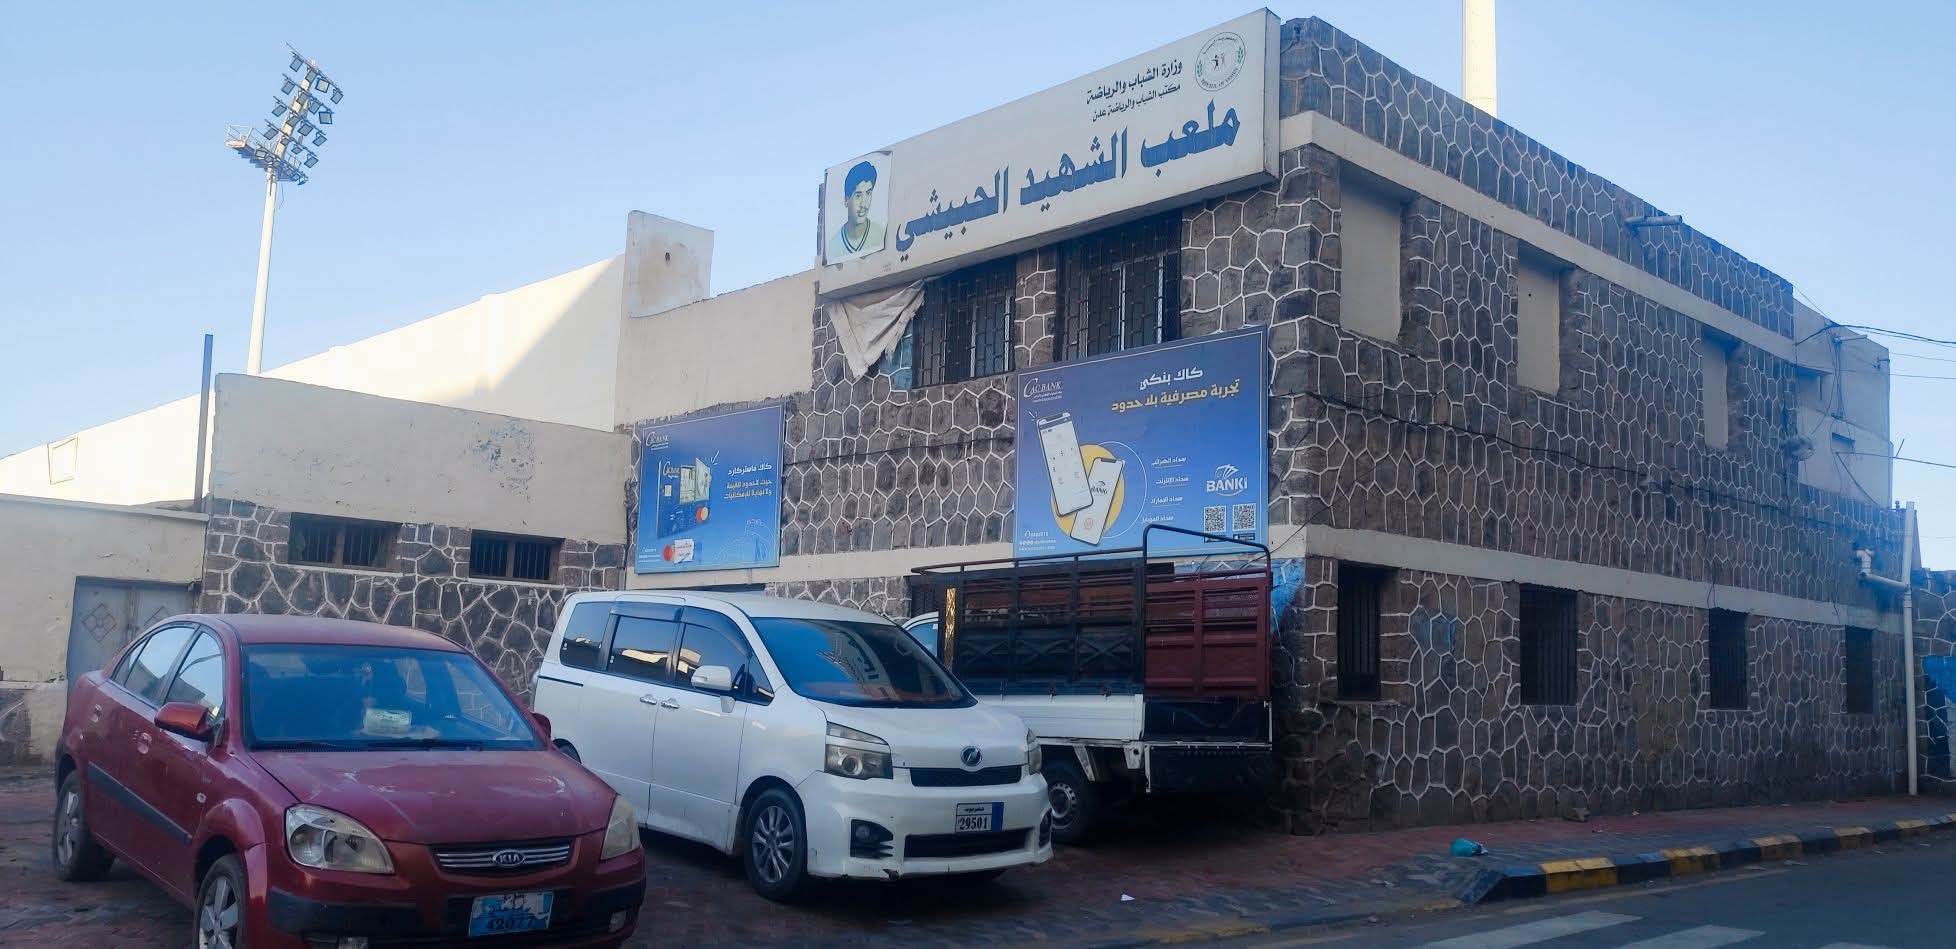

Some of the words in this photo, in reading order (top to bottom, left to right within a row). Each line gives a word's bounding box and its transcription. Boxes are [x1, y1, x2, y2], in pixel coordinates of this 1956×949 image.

[1128, 66, 1160, 91] الشباب
[1161, 59, 1183, 78] وزارة
[1086, 80, 1127, 104] والرياضة
[1135, 89, 1158, 107] الشباب
[1158, 83, 1181, 98] مكتب
[1140, 98, 1241, 178] ملعب
[1019, 125, 1128, 213] الشهيد
[895, 164, 1010, 262] الحبيشي
[1173, 366, 1203, 382] كاك
[1160, 388, 1207, 406] مصرفية
[1210, 378, 1240, 399] تجربة
[499, 854, 520, 864] KIA
